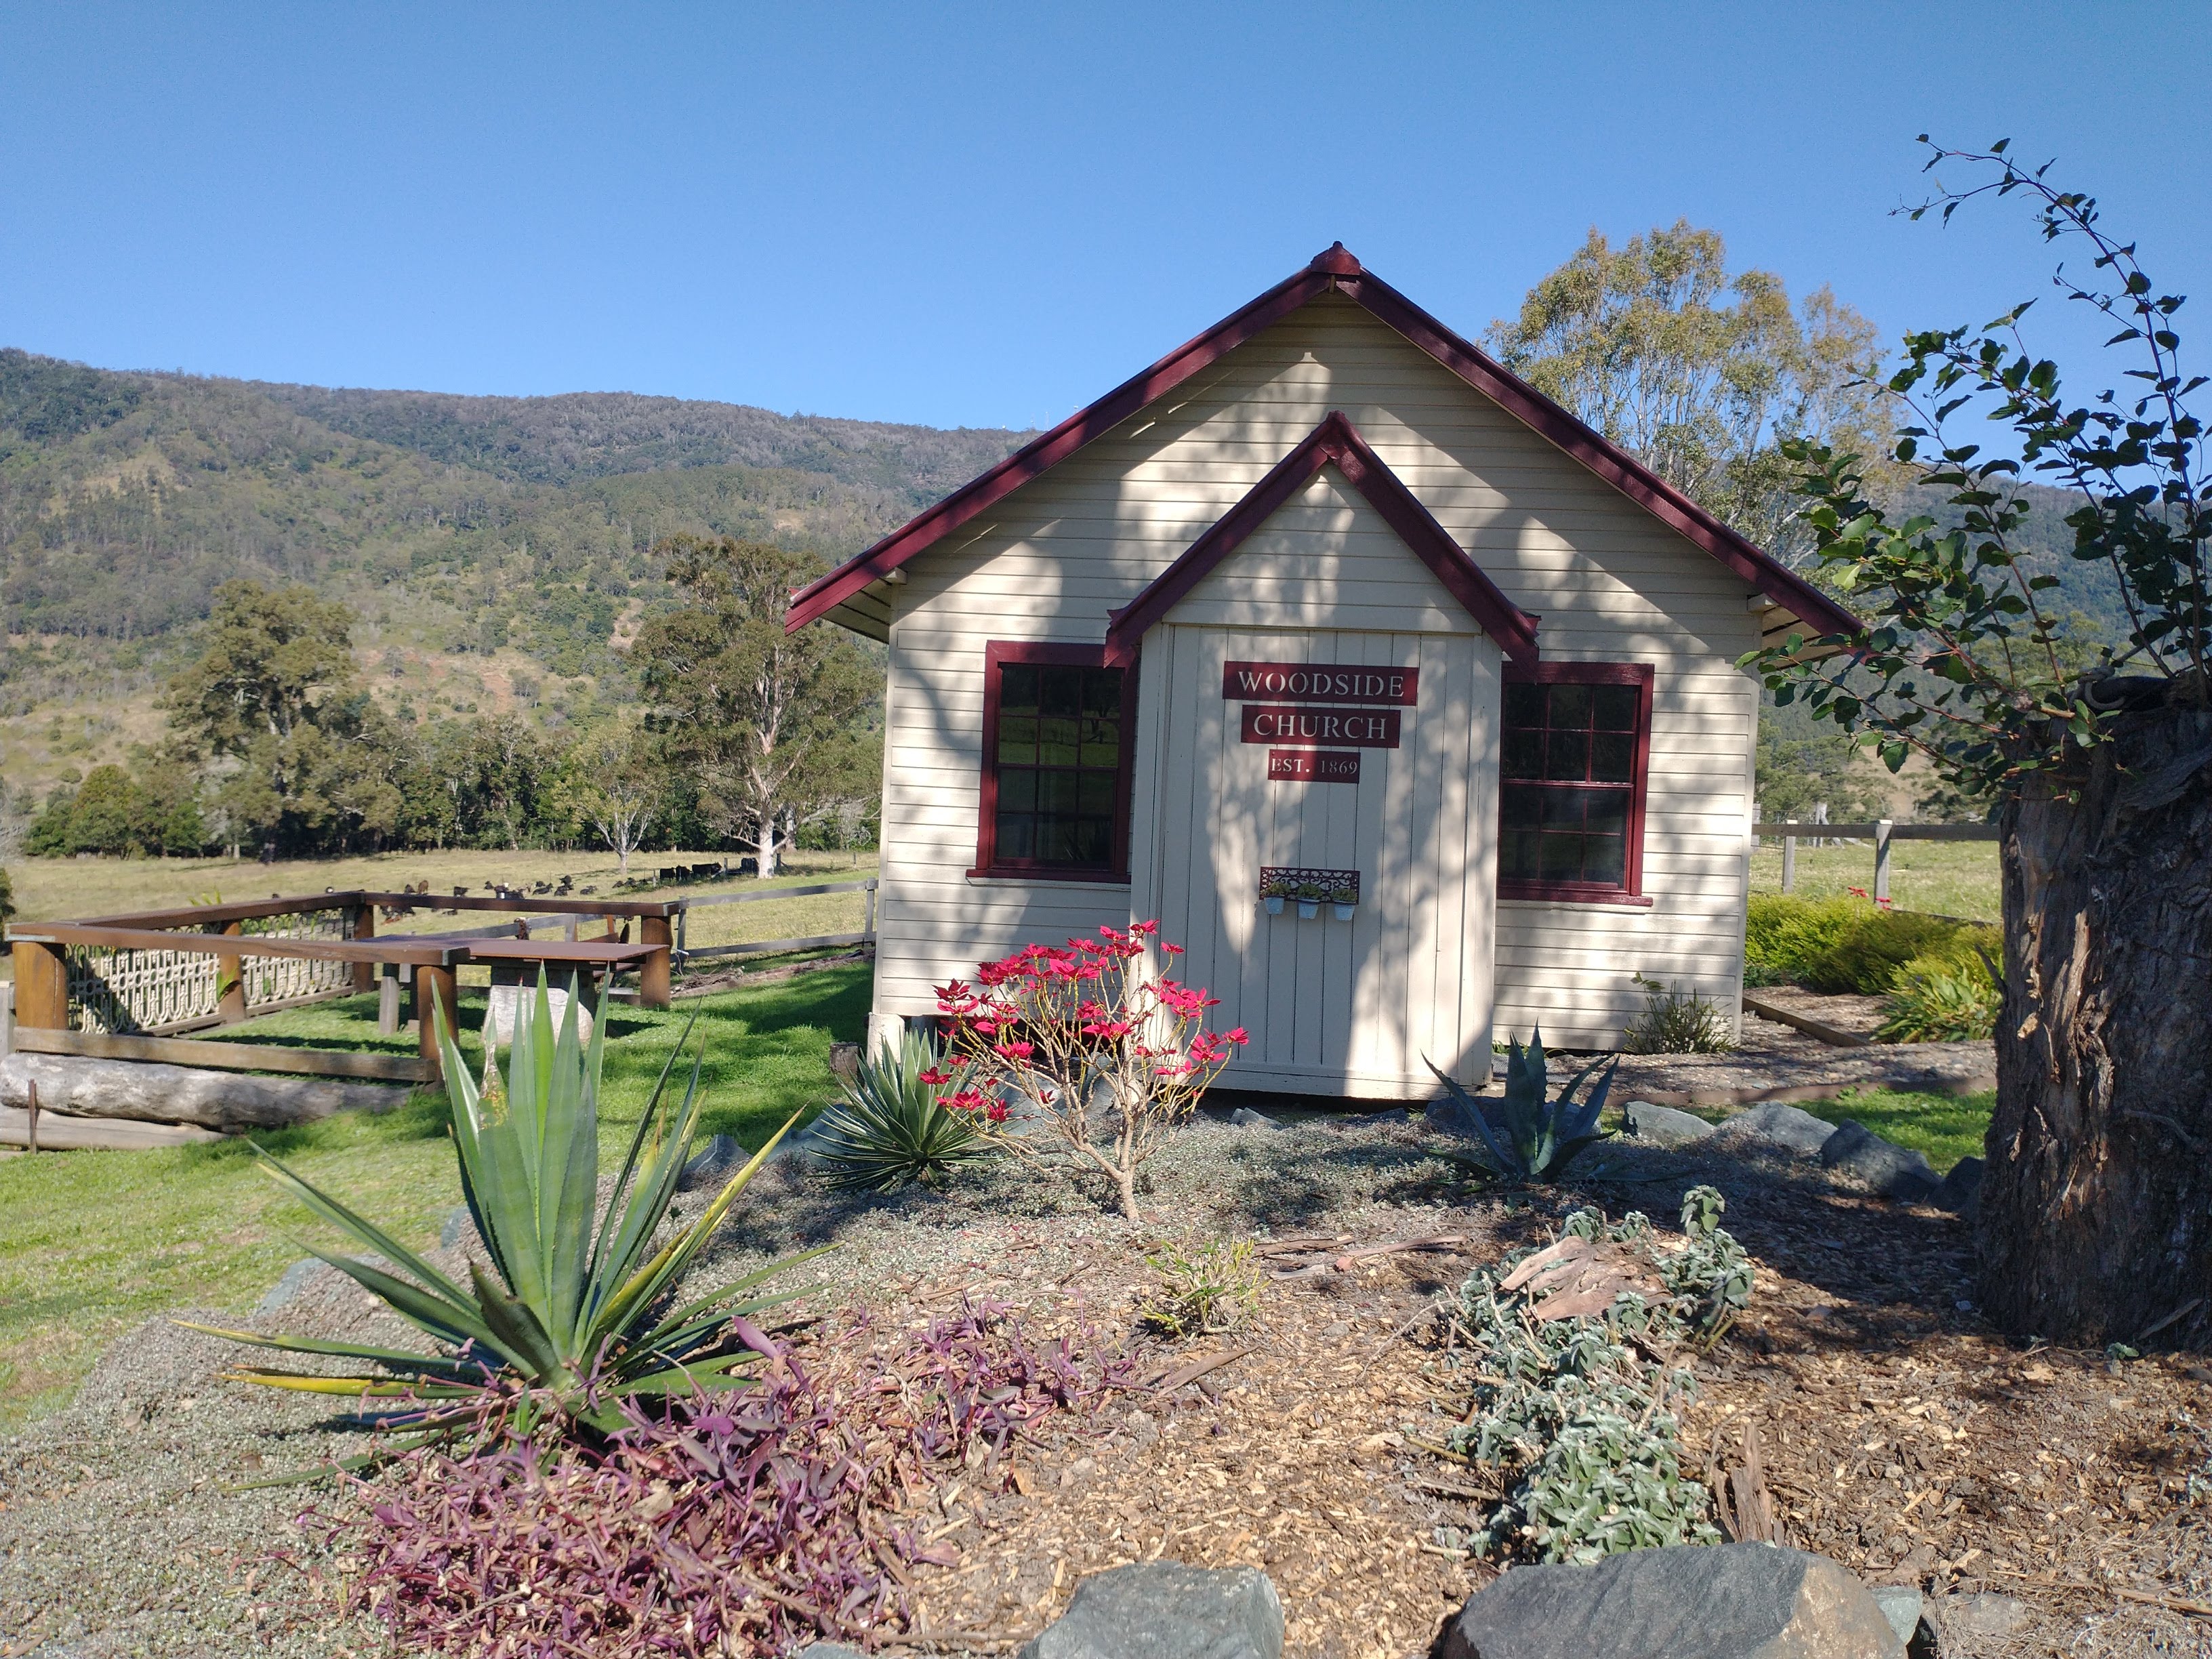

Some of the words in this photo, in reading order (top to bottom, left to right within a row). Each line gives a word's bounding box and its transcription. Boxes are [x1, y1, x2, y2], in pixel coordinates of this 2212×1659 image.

[1237, 671, 1404, 697] WOODSIDE
[1254, 714, 1387, 739] CHURCH
[1271, 758, 1310, 773] EST.
[1321, 760, 1357, 775] 1869
